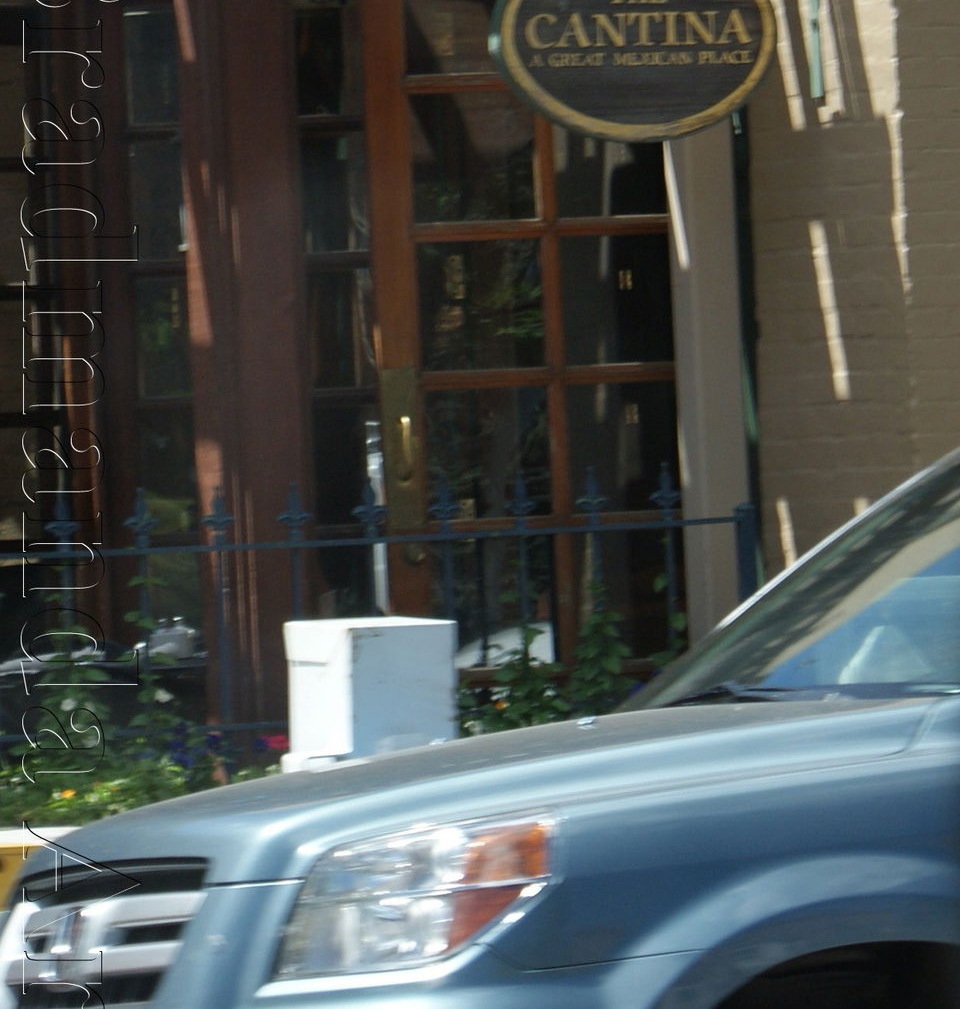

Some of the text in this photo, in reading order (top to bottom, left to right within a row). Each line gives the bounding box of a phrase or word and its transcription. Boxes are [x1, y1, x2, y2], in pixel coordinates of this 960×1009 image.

[525, 9, 752, 49] CANTINA
[530, 50, 753, 67] A GREAT MEXICAN PLACE
